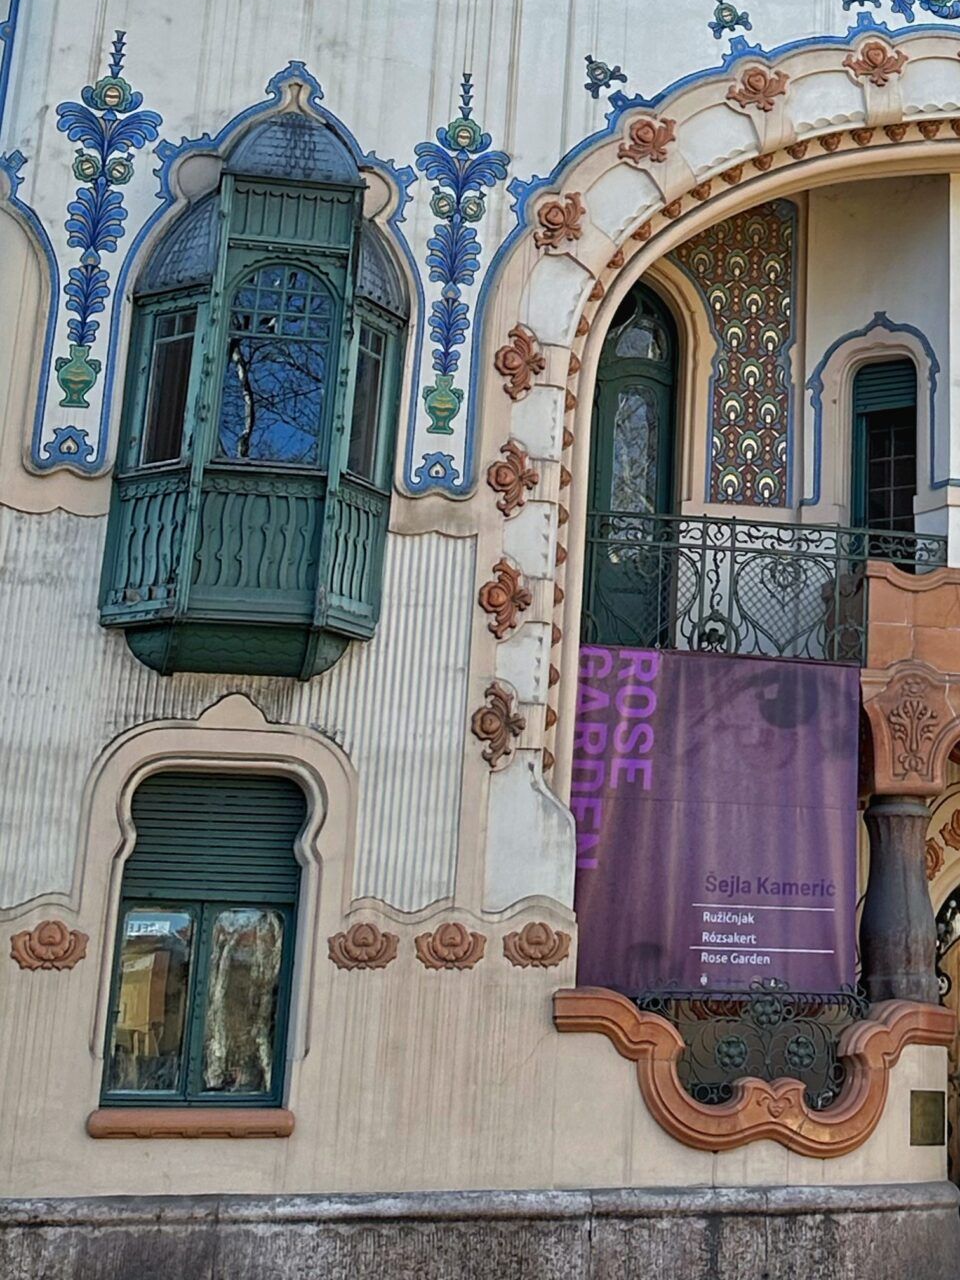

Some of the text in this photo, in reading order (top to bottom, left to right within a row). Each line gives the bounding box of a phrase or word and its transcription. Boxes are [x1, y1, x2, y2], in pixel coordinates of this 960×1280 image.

[609, 649, 661, 791] ROSE
[570, 646, 614, 869] GARDEN
[705, 872, 752, 898] Šejla
[702, 911, 755, 926] Ružičnjak
[702, 931, 757, 945] Rózsakert
[701, 952, 771, 965] Rose Garden
